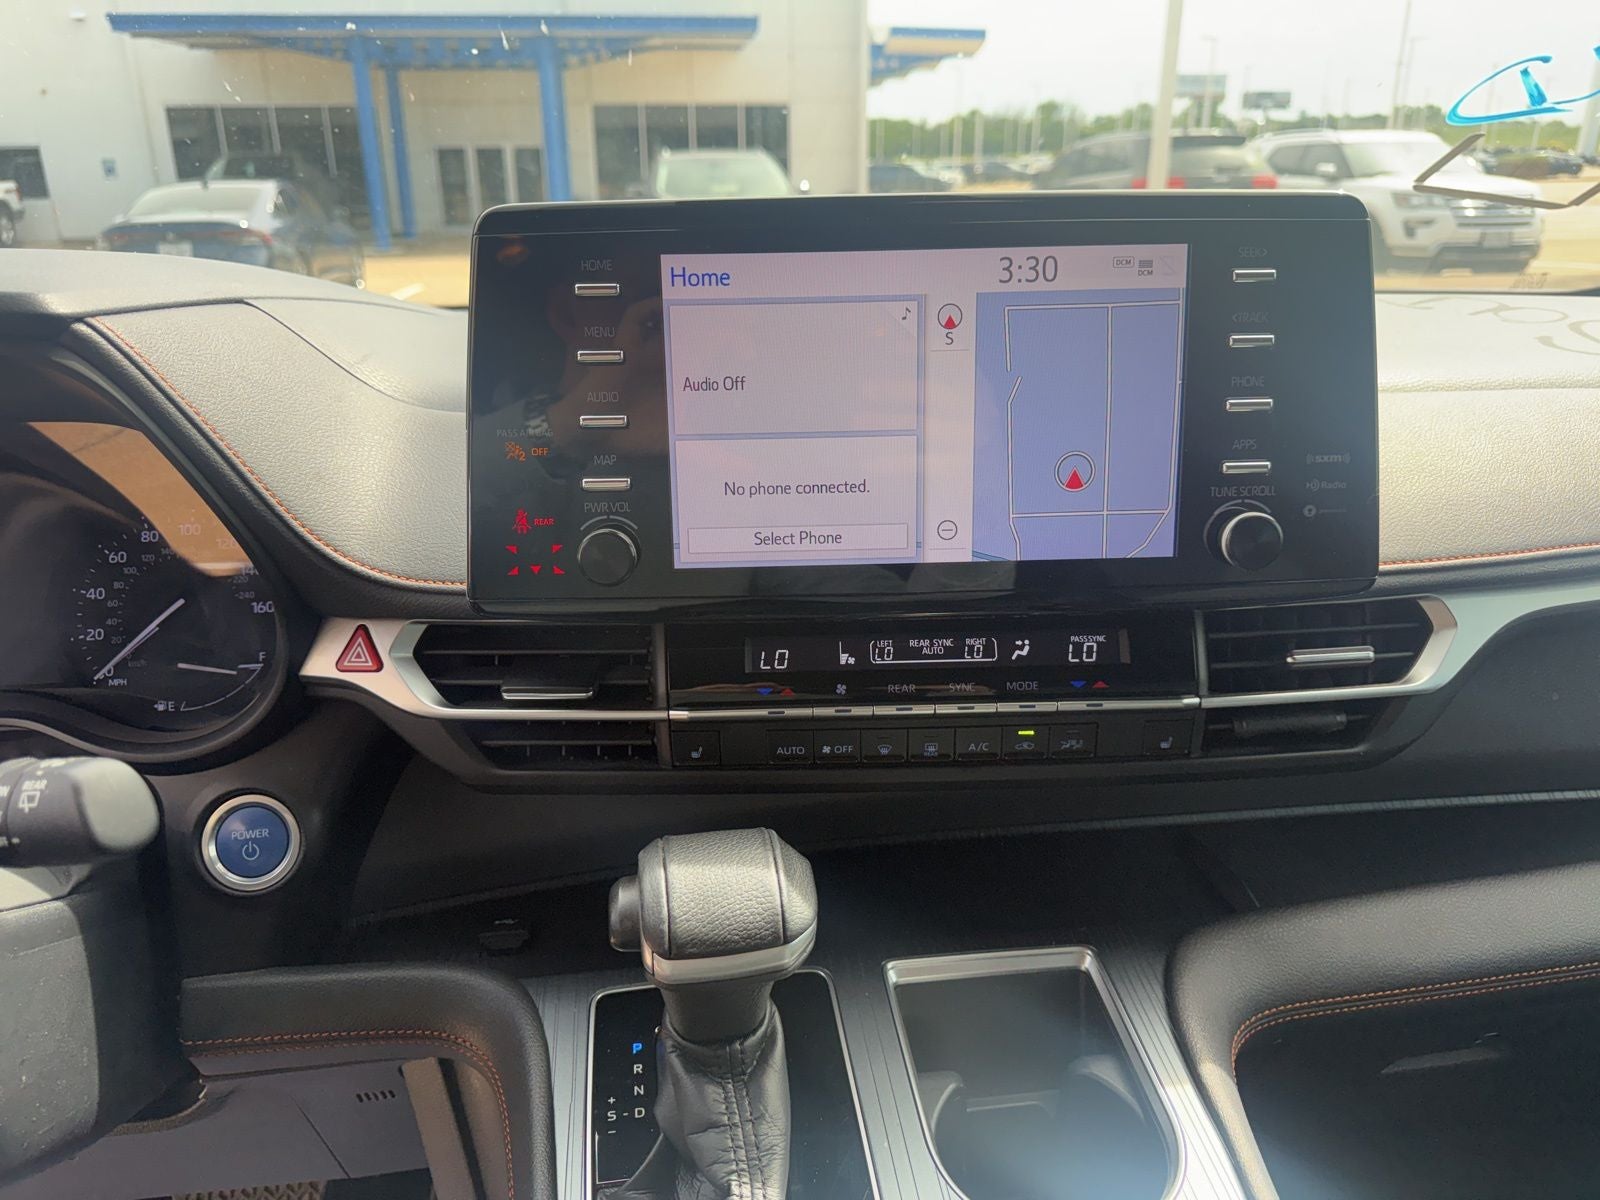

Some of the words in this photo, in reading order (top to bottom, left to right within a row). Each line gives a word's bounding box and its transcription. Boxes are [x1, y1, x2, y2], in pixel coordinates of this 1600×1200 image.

[580, 259, 613, 271] HOME
[1115, 258, 1133, 267] DCM
[998, 255, 1059, 284] 3:30
[1137, 269, 1154, 277] DCM
[670, 266, 731, 288] Home
[584, 327, 616, 338] MENU
[945, 331, 954, 345] S
[683, 376, 719, 392] Audio
[723, 375, 747, 391] Off
[1231, 376, 1265, 388] PHONE
[587, 391, 619, 403] AUDIO
[1232, 439, 1257, 450] APPS
[531, 447, 550, 457] OFF
[593, 455, 617, 466] MAP
[724, 481, 746, 497] No
[749, 480, 792, 499] phone
[795, 479, 871, 495] connected.
[1210, 486, 1238, 498] TUNE
[1239, 485, 1277, 497] SCROLL
[584, 502, 609, 513] PWR
[610, 502, 631, 513] VOL
[534, 518, 555, 526] REAR
[178, 524, 201, 536] 100
[141, 531, 159, 543] 80
[753, 531, 796, 546] Select
[799, 530, 843, 545] Phone
[108, 551, 127, 564] 60
[123, 567, 137, 575] 100
[114, 582, 125, 590] 80
[86, 587, 106, 600] 40
[107, 600, 119, 608] 60
[251, 601, 275, 614] 160
[106, 618, 118, 626] 40
[86, 628, 105, 641] 20
[1070, 635, 1088, 643] PASS
[1088, 635, 1107, 643] SYNC
[111, 636, 122, 645] 20
[933, 639, 954, 647] SYNC
[259, 652, 266, 661] F
[921, 647, 944, 655] AUTO
[108, 678, 128, 687] MPH
[949, 683, 976, 692] SYNC
[1006, 681, 1039, 691] MODE
[888, 684, 916, 693] REAR
[168, 702, 175, 712] E
[776, 746, 805, 755] AUTO
[834, 745, 854, 754] OFF
[968, 742, 989, 751] A/C
[231, 828, 270, 841] POWER
[632, 1042, 643, 1054] P
[633, 1063, 643, 1075] R
[633, 1084, 644, 1096] N
[607, 1110, 617, 1122] S
[634, 1107, 646, 1119] D
